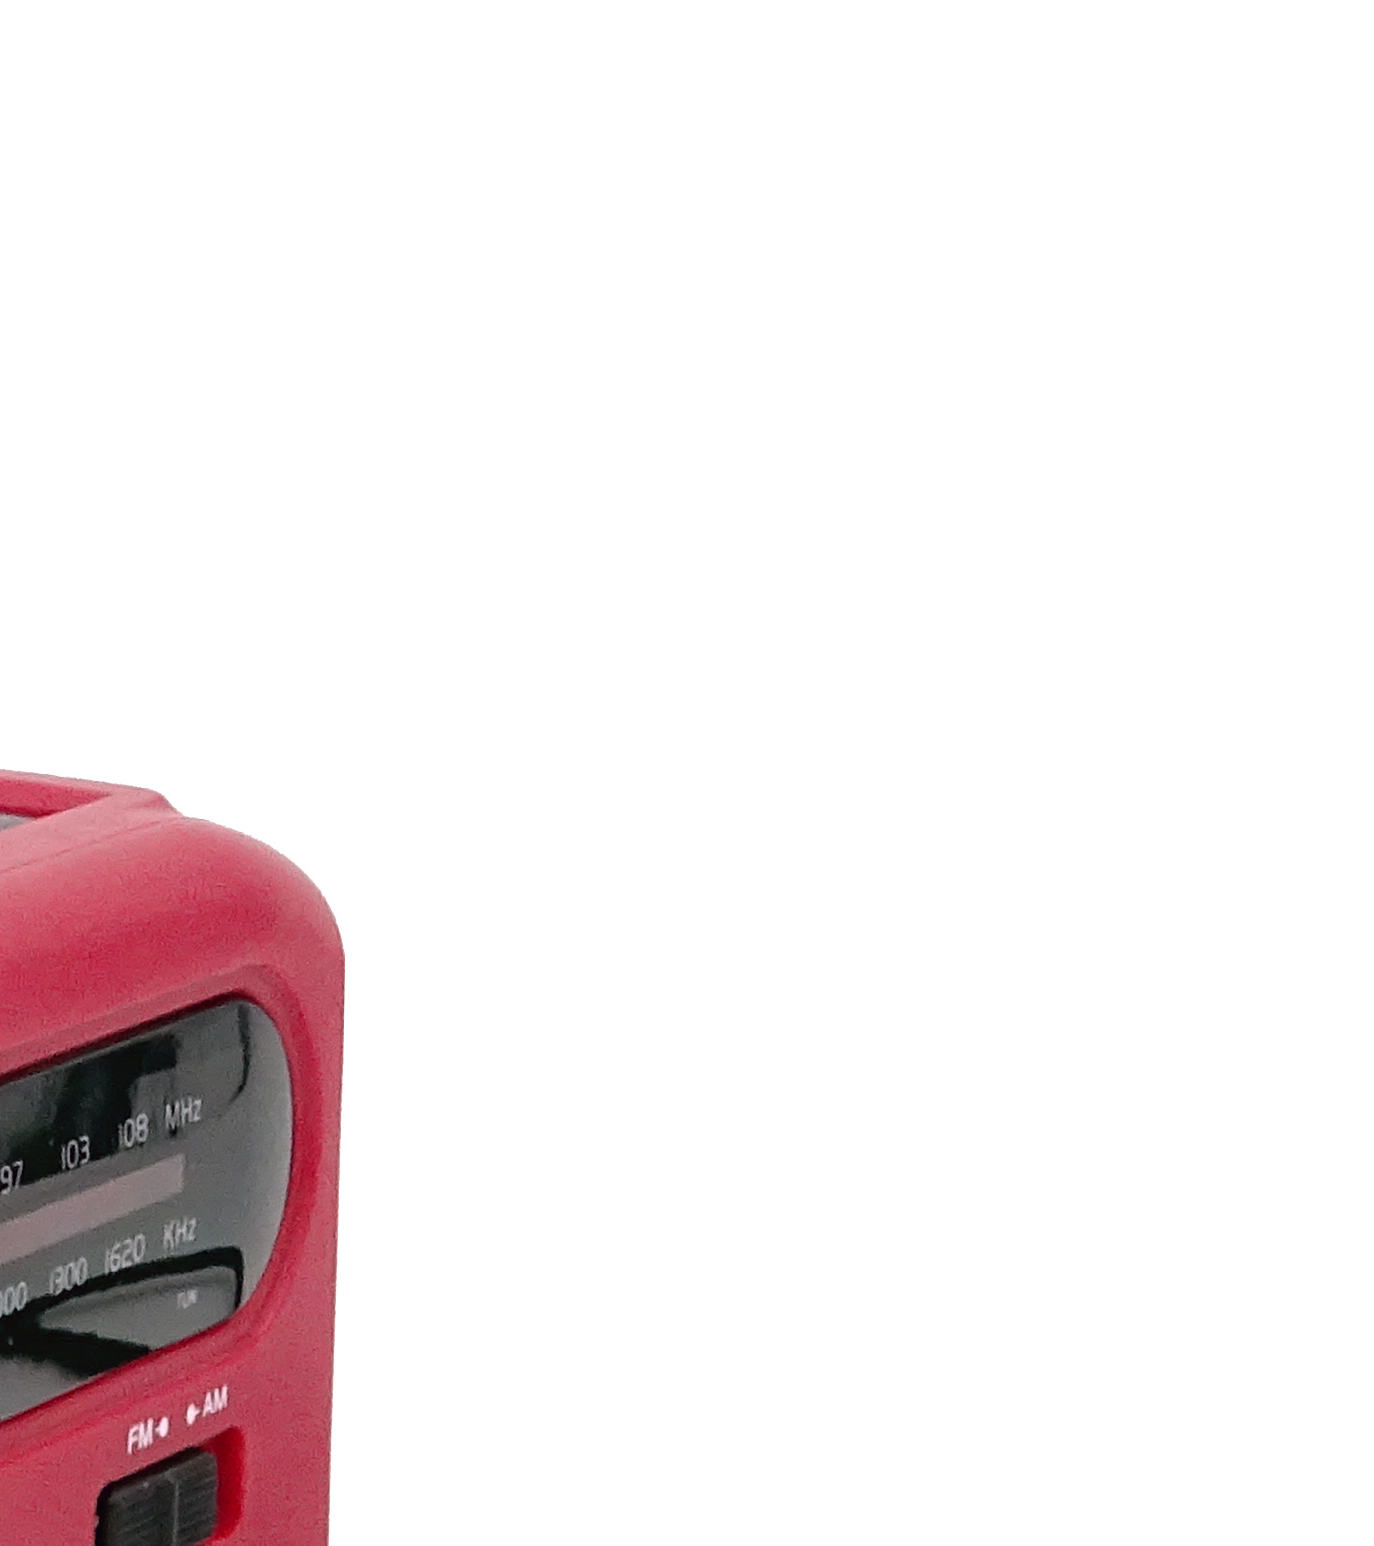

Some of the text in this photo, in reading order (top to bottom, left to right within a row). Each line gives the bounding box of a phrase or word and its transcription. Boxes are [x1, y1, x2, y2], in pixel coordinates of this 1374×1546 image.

[0, 1160, 24, 1195] 97
[60, 1135, 91, 1170] 103
[118, 1113, 150, 1148] 108
[49, 1257, 89, 1295] 1300
[104, 1233, 146, 1274] 1620
[127, 1384, 228, 1454] FM AM
